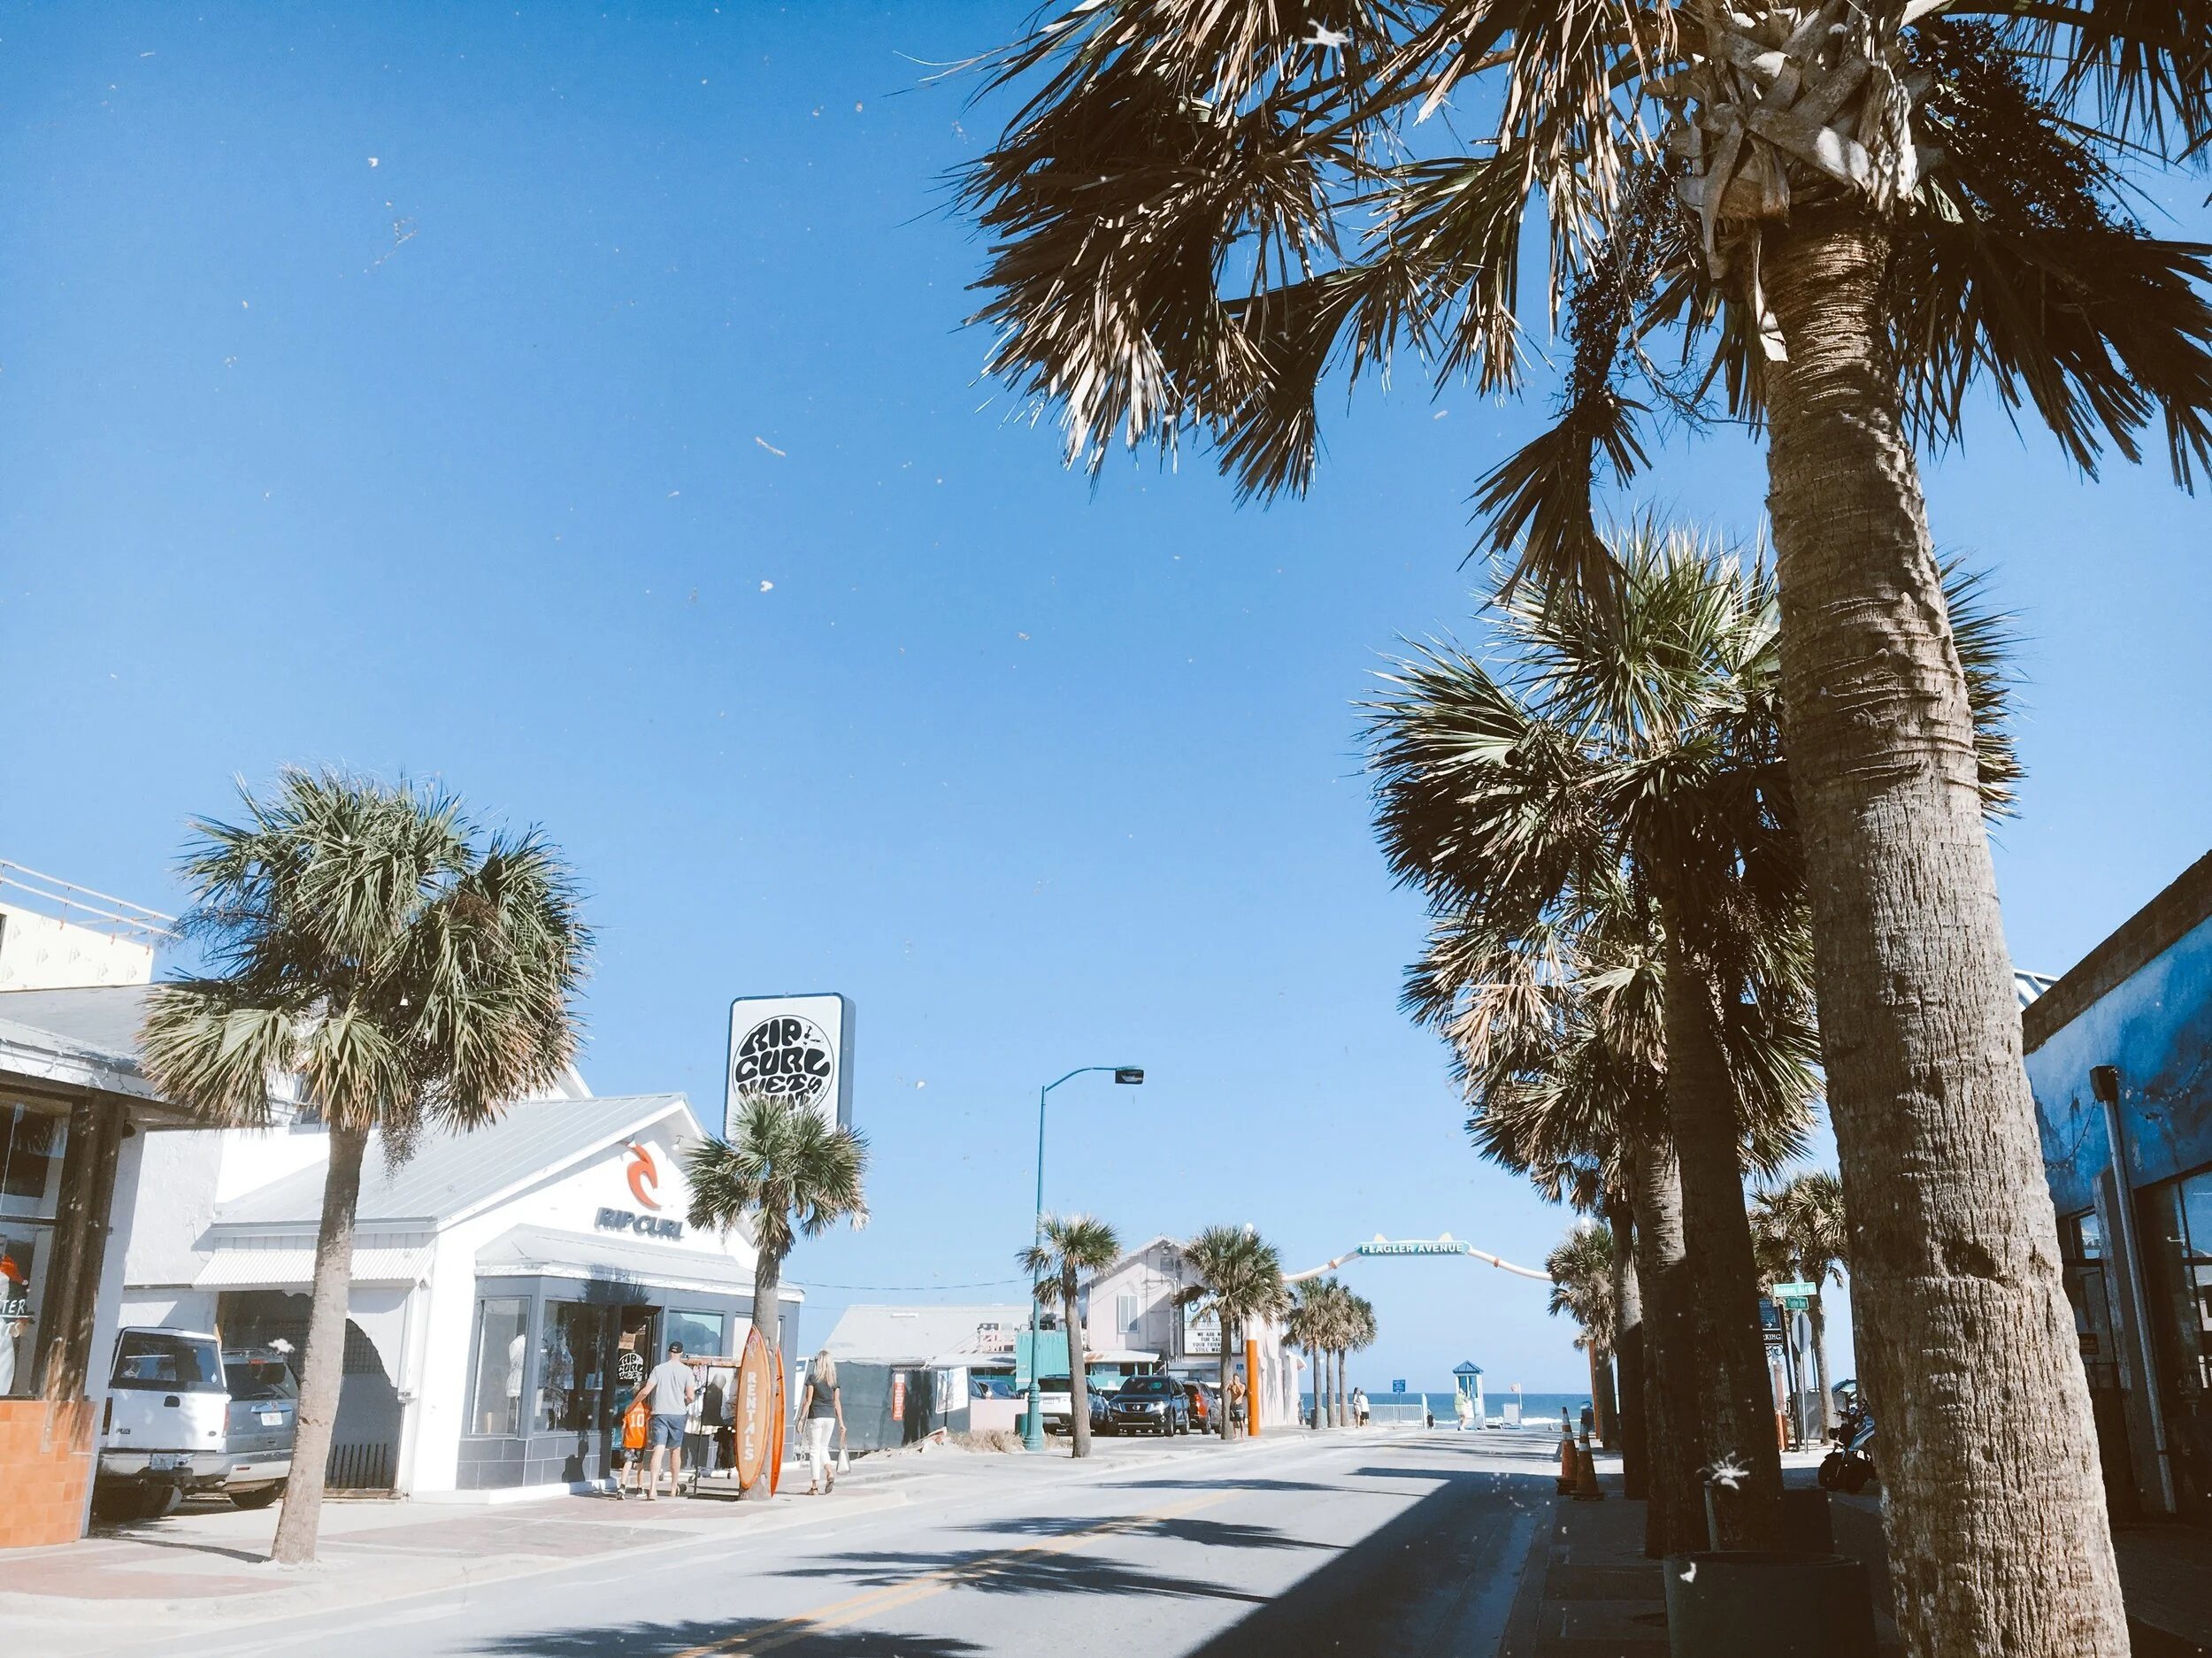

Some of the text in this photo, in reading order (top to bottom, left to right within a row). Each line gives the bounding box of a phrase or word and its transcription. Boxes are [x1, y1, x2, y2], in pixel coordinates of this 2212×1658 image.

[740, 1018, 802, 1057] RIP
[735, 1047, 830, 1083] CURL
[1362, 1242, 1463, 1254] FLAGLER AVENUE
[0, 1299, 26, 1316] TER
[618, 1354, 637, 1366] RIP
[629, 1413, 645, 1428] 10
[743, 1371, 758, 1461] RENTALS
